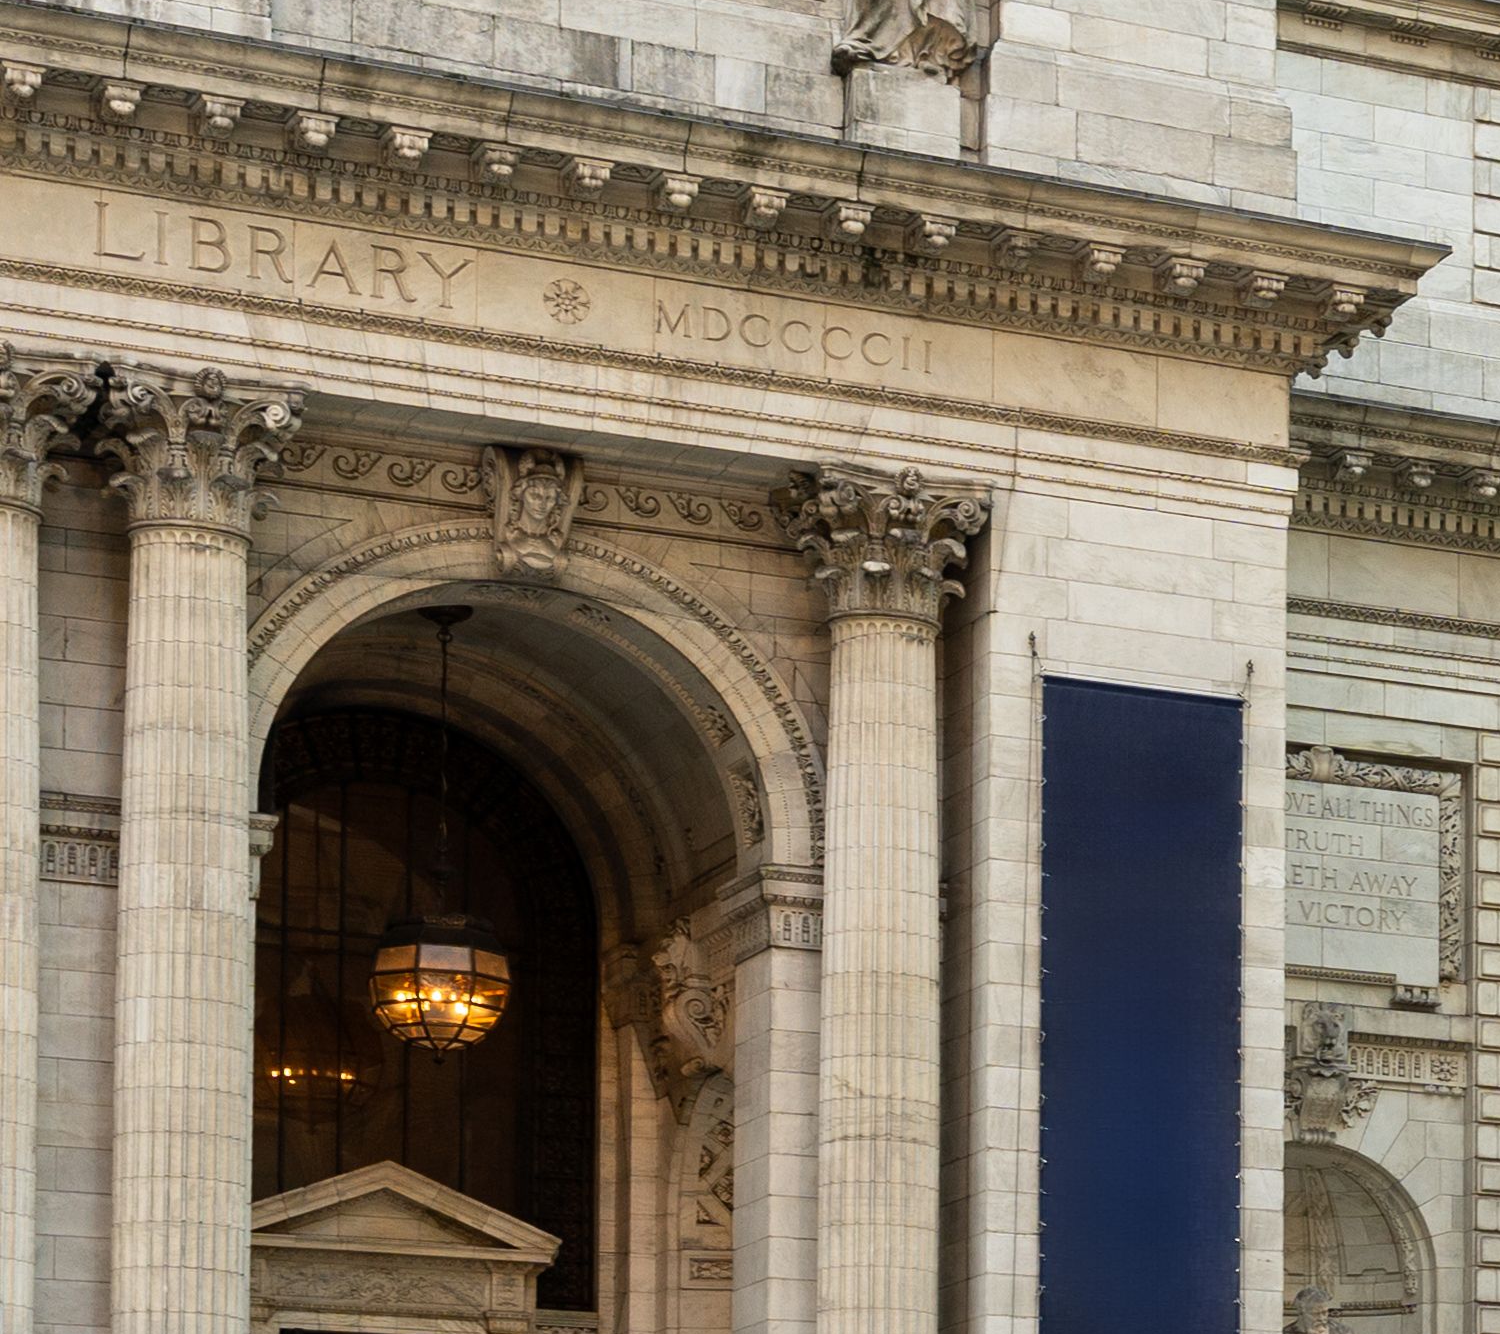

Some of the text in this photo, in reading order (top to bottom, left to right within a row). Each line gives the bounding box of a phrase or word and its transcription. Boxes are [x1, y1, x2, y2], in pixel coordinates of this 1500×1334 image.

[93, 199, 934, 375] LIBRARY MDCCCCII
[1321, 796, 1357, 820] ALL
[1360, 799, 1434, 828] THINGS
[1285, 827, 1364, 857] TRUTH
[1348, 870, 1419, 898] AWAY
[1297, 899, 1408, 932] VICTORY
